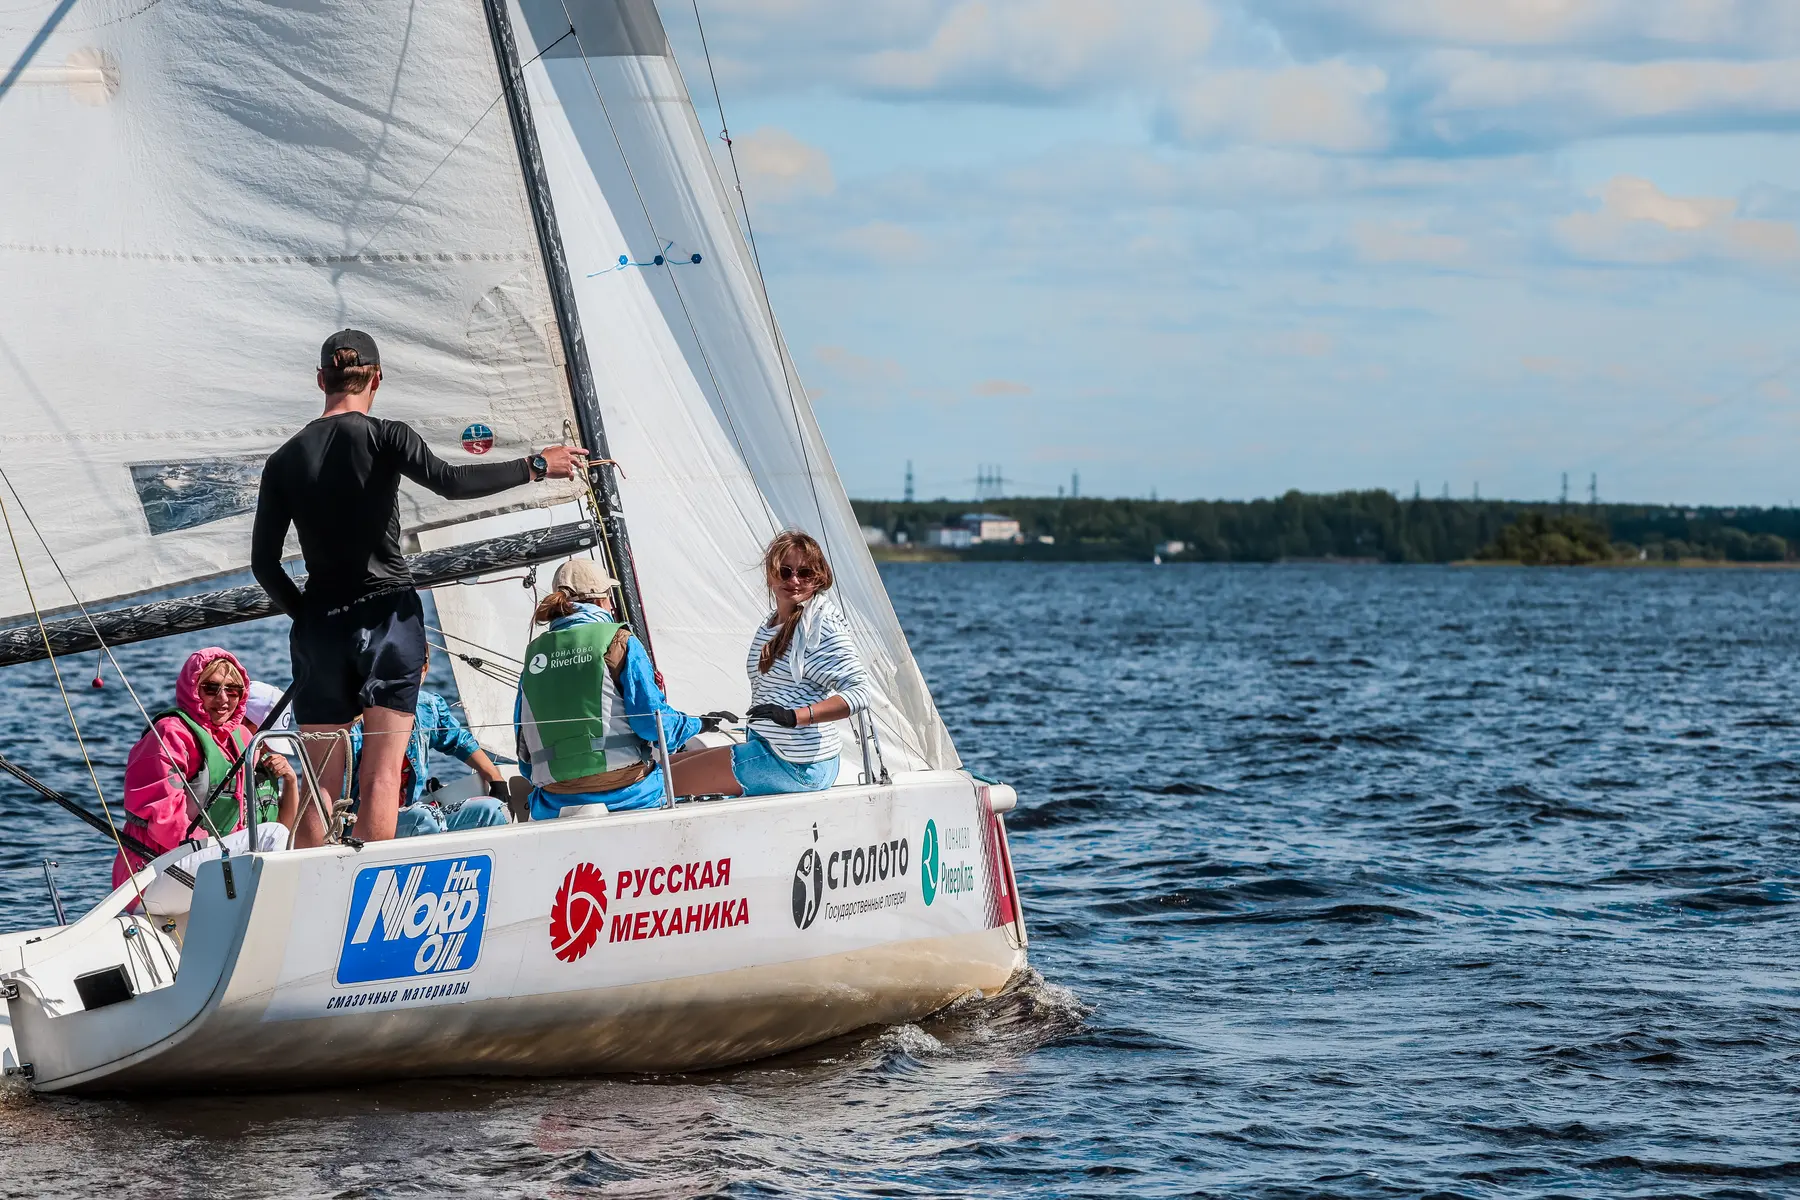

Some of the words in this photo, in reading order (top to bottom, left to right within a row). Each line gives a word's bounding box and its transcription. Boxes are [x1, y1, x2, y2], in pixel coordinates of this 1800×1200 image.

[550, 654, 593, 669] RiverClub
[551, 645, 593, 658] КОНАКОВО
[945, 827, 971, 850] КОНАКОВО
[615, 857, 732, 900] РУССКАЯ
[827, 837, 909, 890] СТОЛОТО
[941, 860, 974, 900] РиверКлаб
[608, 897, 750, 944] МЕХАНИКА
[824, 896, 884, 922] Государственные
[884, 890, 907, 909] лотереи
[414, 932, 468, 973] OIL
[326, 990, 398, 1009] смазочные
[401, 981, 470, 1001] материалы
